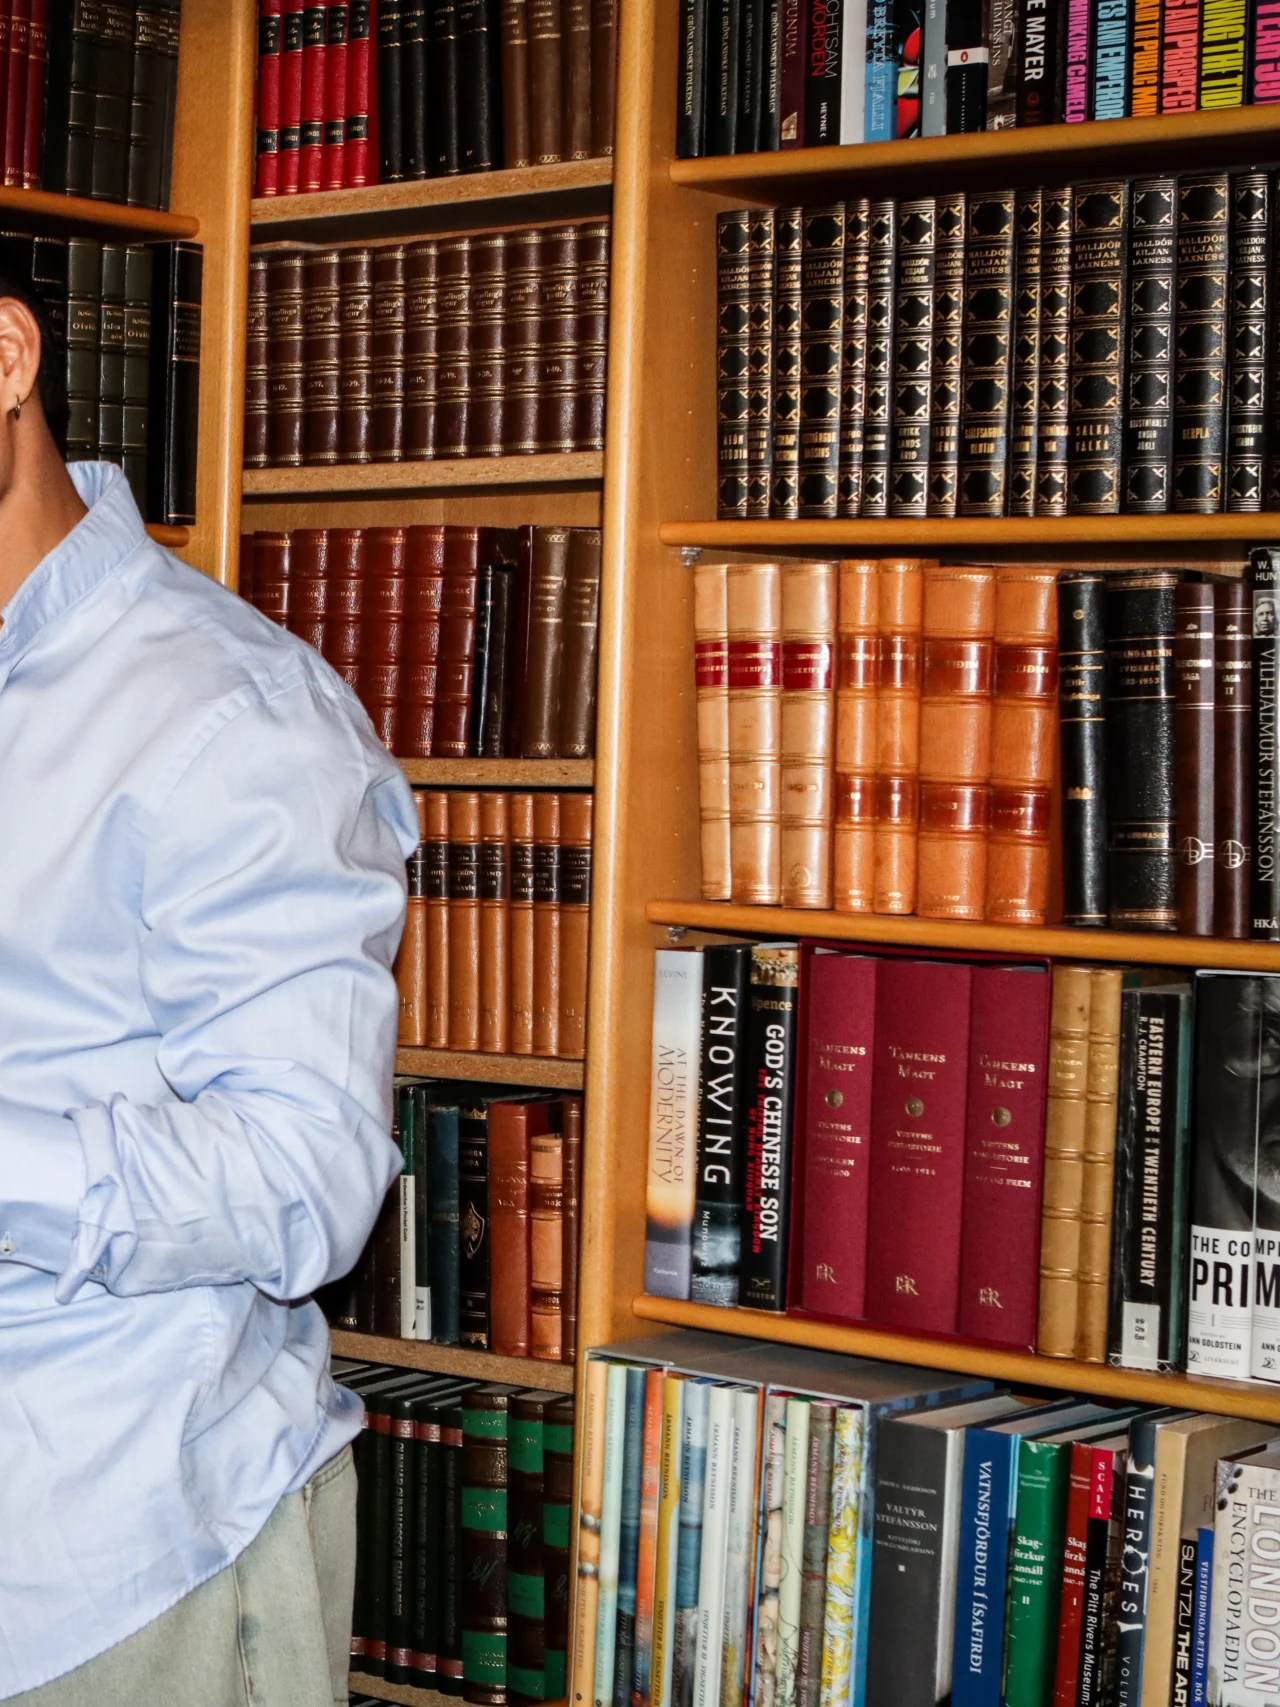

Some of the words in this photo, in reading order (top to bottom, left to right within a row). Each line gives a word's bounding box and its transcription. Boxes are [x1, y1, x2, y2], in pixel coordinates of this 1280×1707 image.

[873, 7, 887, 73] BREYTA
[1024, 16, 1046, 82] MAYER
[1097, 20, 1126, 47] AND
[1132, 40, 1159, 86] PUBLIC
[1162, 34, 1198, 114] PROSPECT
[1201, 40, 1245, 76] THE
[871, 75, 886, 131] FJALLI
[1065, 64, 1087, 123] CAMELO
[1095, 46, 1126, 120] EMPEROR
[1131, 87, 1158, 117] MIN
[1201, 75, 1244, 110] TID
[820, 102, 828, 131] HEYNE
[1259, 649, 1276, 763] VILHJÁLMUR
[1258, 768, 1277, 881] STEFÁNSSON
[659, 970, 688, 980] LEVINE
[677, 1047, 687, 1066] AT
[765, 1023, 786, 1090] GOD'S
[888, 1045, 947, 1064] TANKENS
[1136, 1035, 1146, 1091] CRAMPTON
[1148, 1017, 1165, 1075] EASTERN
[675, 1074, 687, 1102] THE
[703, 986, 738, 1186] KNOWING
[897, 1064, 937, 1081] MAGT
[984, 1072, 1025, 1090] MAGT
[652, 1044, 675, 1184] MODERNITY
[1145, 1078, 1163, 1132] EUROPE
[674, 1109, 686, 1159] DAWN
[761, 1095, 783, 1190] CHINESE
[673, 1165, 684, 1184] OF
[1141, 1148, 1161, 1222] TWENTIETH
[758, 1196, 779, 1242] SON
[1139, 1227, 1157, 1287] CENTURY
[1193, 1235, 1219, 1254] THE
[1188, 1336, 1200, 1347] ANN
[1201, 1338, 1242, 1351] GOLDSTEIN
[1204, 1355, 1241, 1366] LIVERIGHT
[663, 1412, 672, 1454] ÁRMANN
[684, 1416, 693, 1454] ÁRMANN
[711, 1422, 721, 1460] ÁRMANN
[730, 1426, 740, 1464] ÁRMANN
[810, 1435, 820, 1475] ÁRMANN
[662, 1455, 671, 1499] REYNISSON
[682, 1456, 692, 1503] REYNISSON
[709, 1462, 719, 1509] REYNISSON
[729, 1465, 739, 1513] REYNISSON
[1094, 1461, 1107, 1515] SCALA
[1247, 1487, 1278, 1502] THE
[808, 1476, 818, 1525] REYNISSON
[886, 1502, 927, 1519] VALTÝR
[876, 1512, 938, 1533] STEFÁNSSON
[973, 1460, 993, 1587] VATNSFJÖRÐUR
[1017, 1535, 1043, 1549] Skag-
[1014, 1563, 1044, 1576] annáll
[1122, 1485, 1147, 1614] HEROES
[1179, 1544, 1194, 1586] SUN
[1022, 1595, 1030, 1604] II
[1089, 1569, 1101, 1590] The
[1222, 1502, 1248, 1684] ENCYCLOPAEDIA
[1242, 1504, 1280, 1696] LONDON
[1088, 1593, 1100, 1614] Pitt
[1178, 1589, 1193, 1628] TZU
[969, 1602, 989, 1674] ÍSAFIRÐI
[1086, 1615, 1098, 1651] Rivers
[1176, 1631, 1191, 1670] THE
[1082, 1653, 1096, 1706] Museum:
[1173, 1671, 1189, 1707] ART
[1194, 1682, 1205, 1703] BÓK
